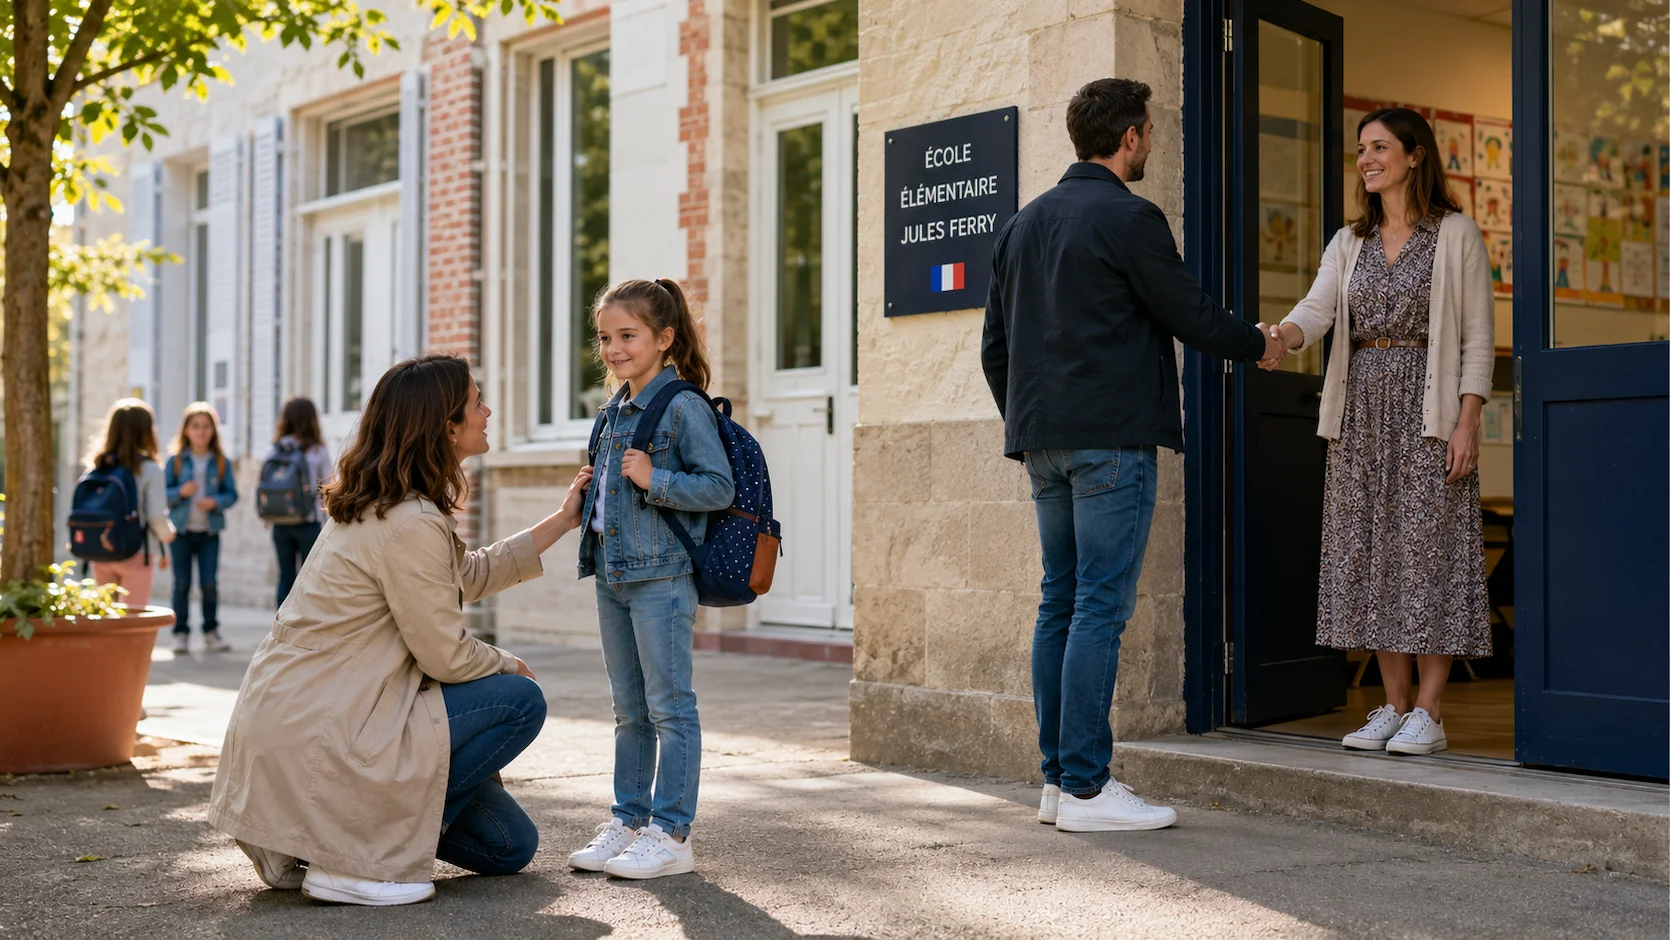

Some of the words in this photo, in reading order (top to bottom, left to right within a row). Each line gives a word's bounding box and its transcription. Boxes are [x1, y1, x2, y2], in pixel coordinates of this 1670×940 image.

[925, 143, 972, 169] ÉCOLE
[900, 175, 998, 209] ÉLÉMENTAIRE
[900, 220, 945, 245] JULES
[950, 213, 997, 238] FERRY
